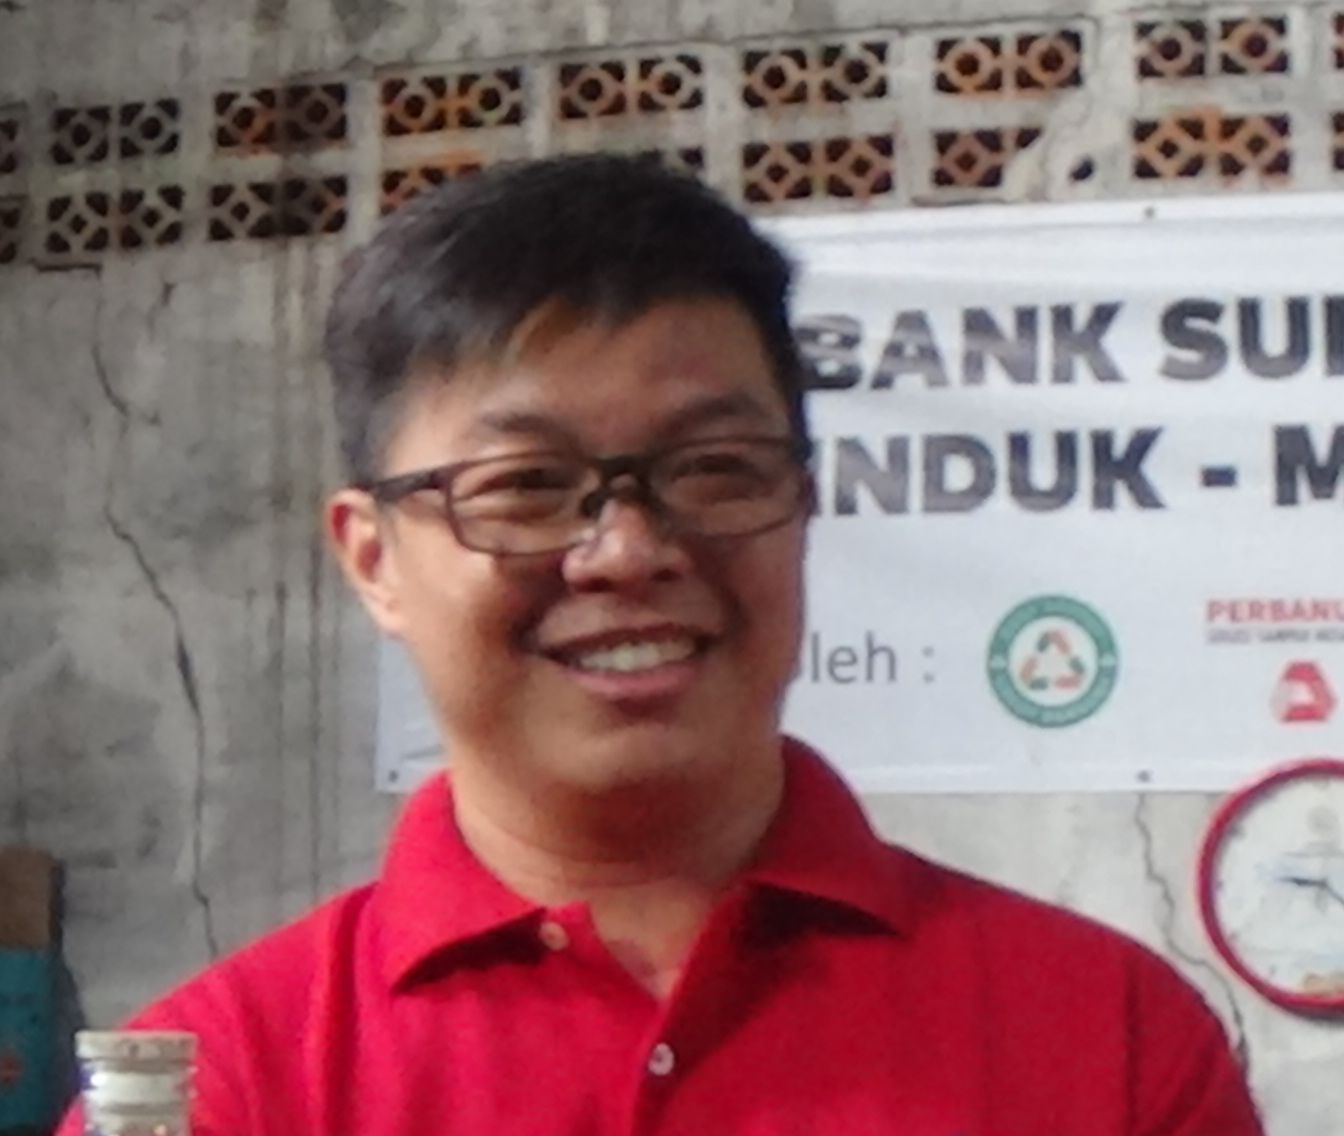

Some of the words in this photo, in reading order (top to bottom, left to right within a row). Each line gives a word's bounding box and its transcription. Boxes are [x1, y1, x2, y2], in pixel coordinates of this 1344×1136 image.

[795, 301, 1126, 391] BANK
[1200, 465, 1238, 488] -
[802, 630, 897, 685] leh
